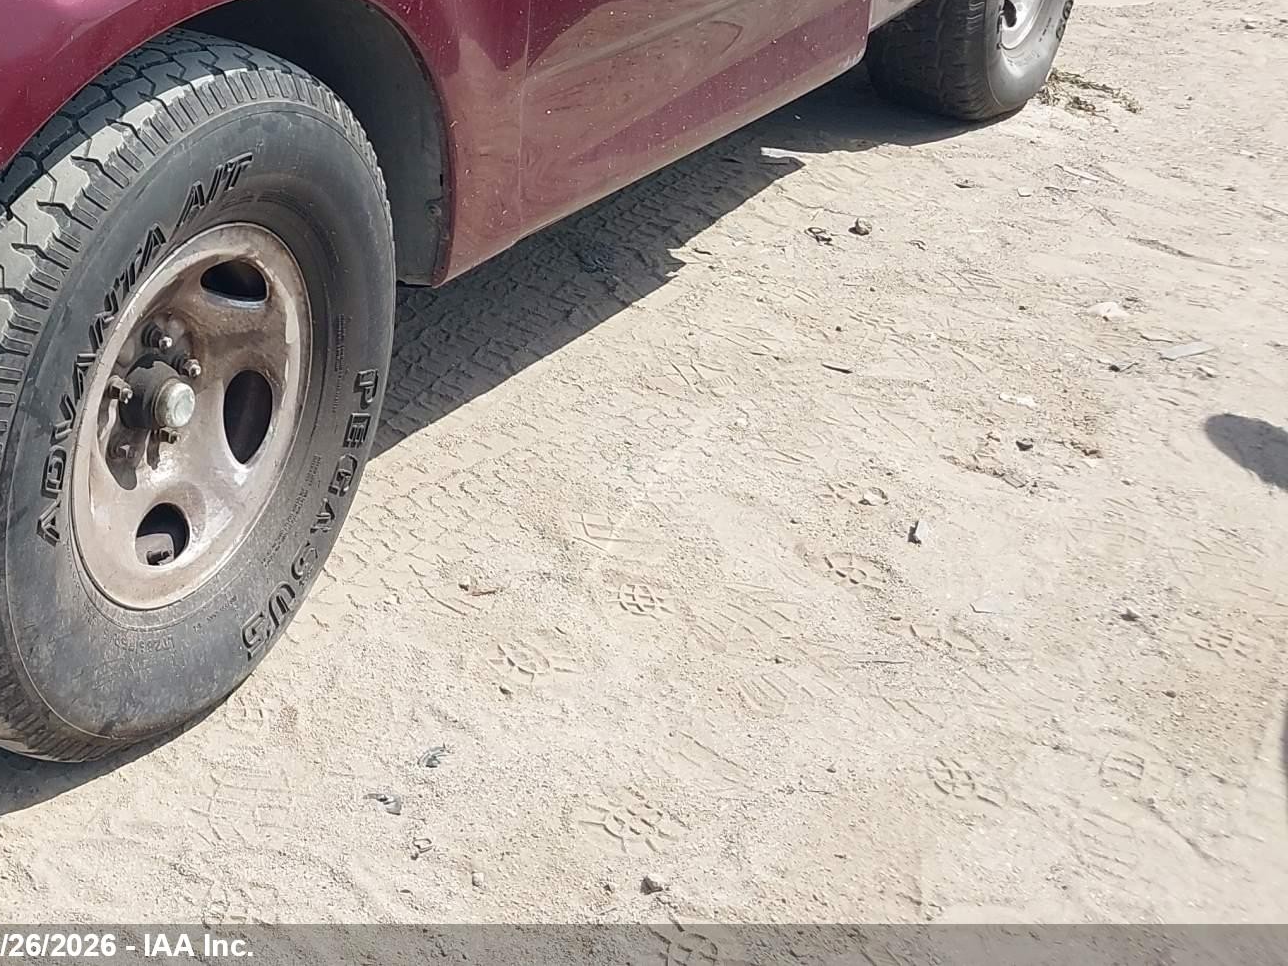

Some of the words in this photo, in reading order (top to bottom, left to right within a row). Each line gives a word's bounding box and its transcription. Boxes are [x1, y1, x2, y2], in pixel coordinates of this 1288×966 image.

[36, 222, 167, 547] ADVANTA
[174, 151, 254, 231] A/T
[241, 368, 379, 662] PEGASUS
